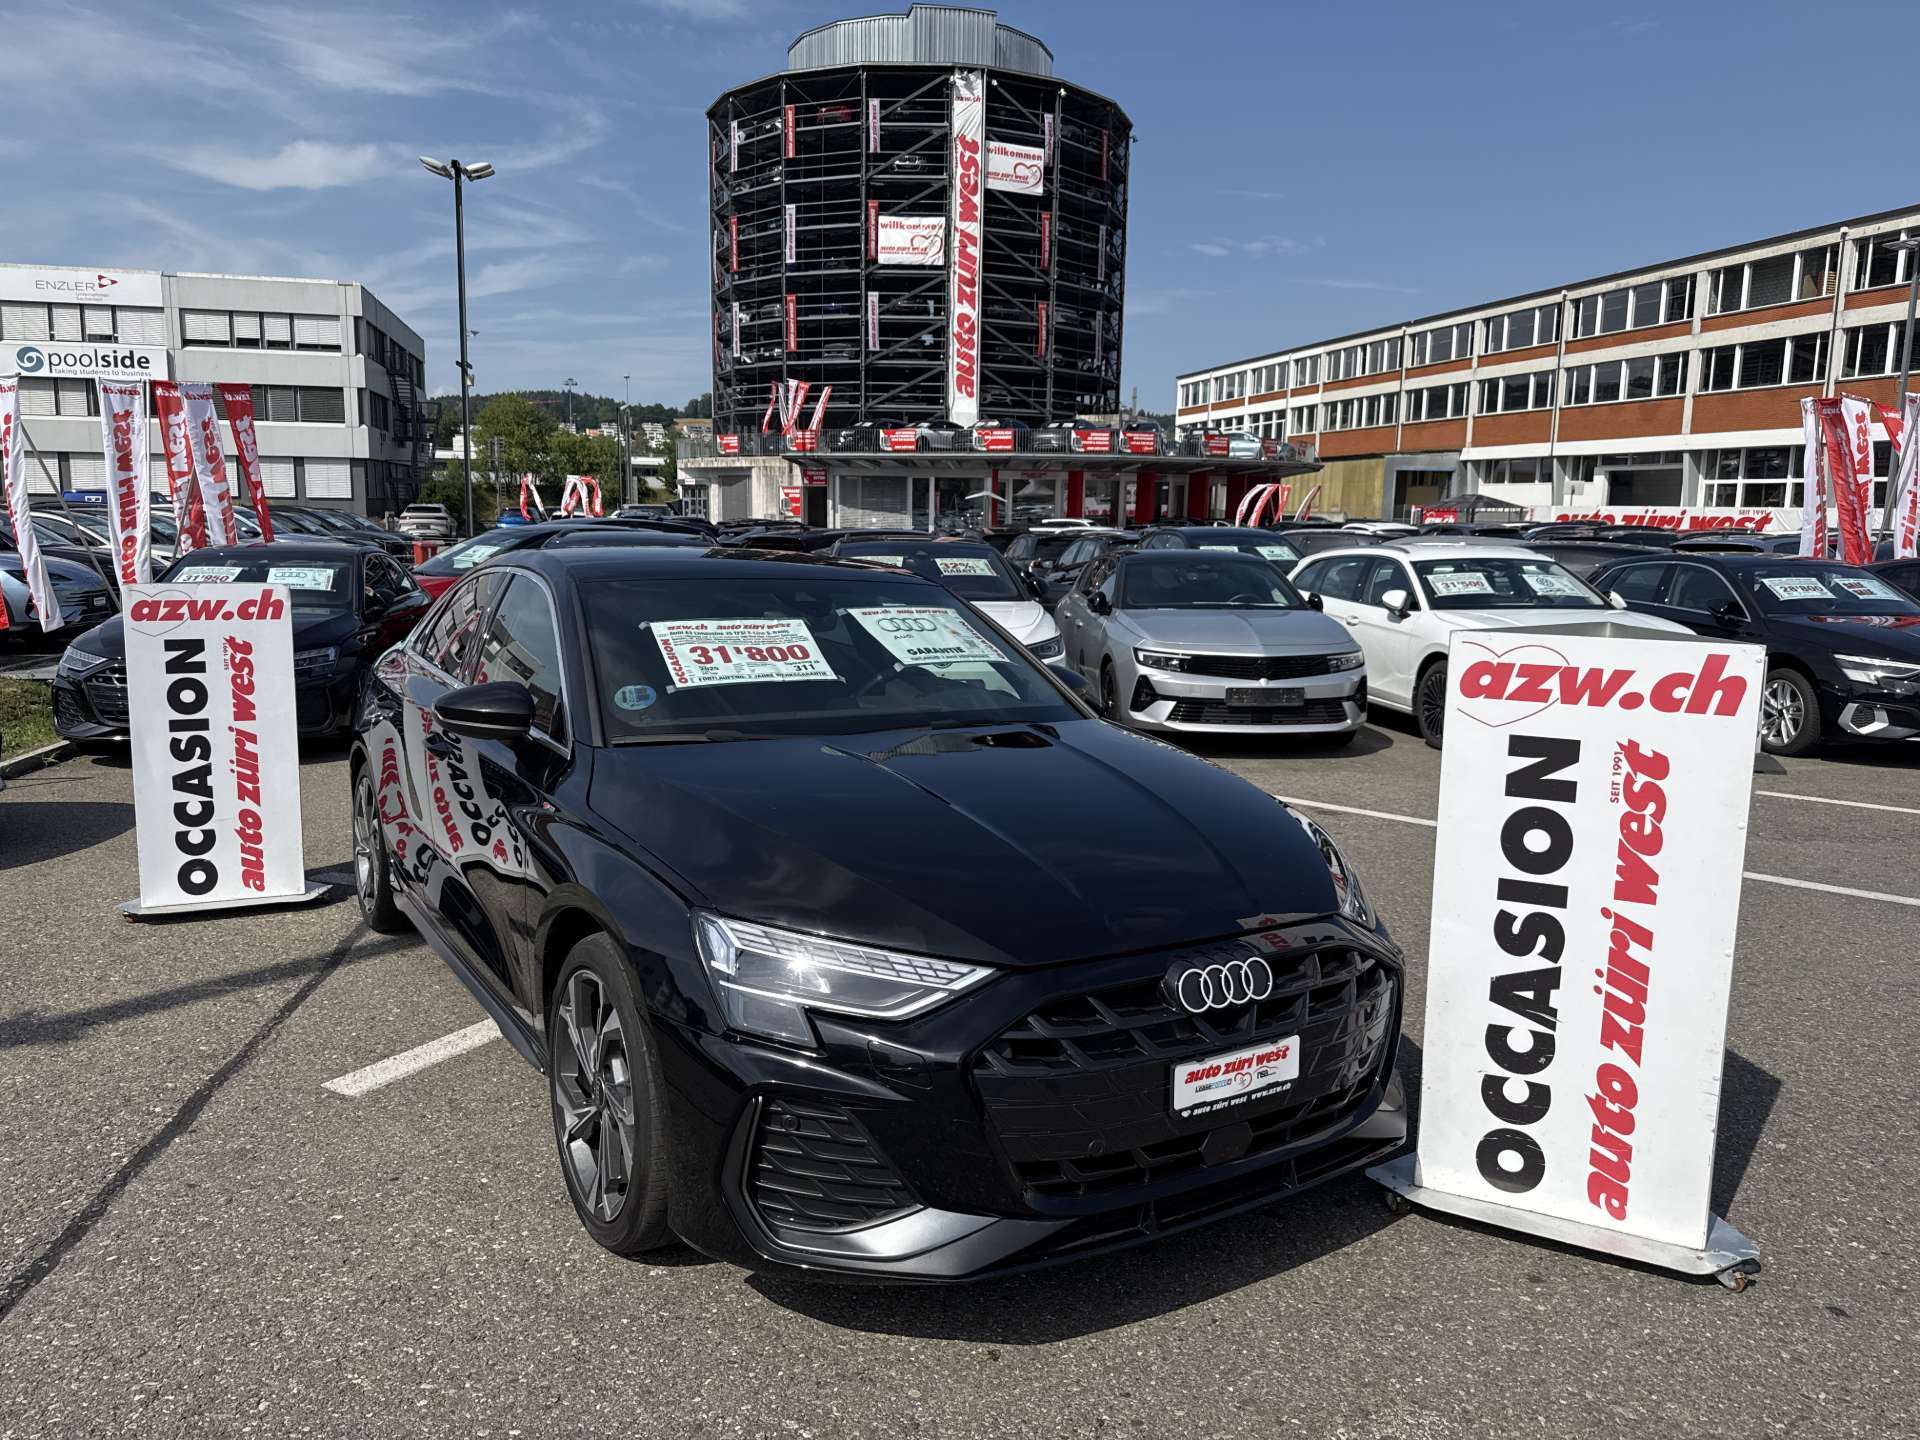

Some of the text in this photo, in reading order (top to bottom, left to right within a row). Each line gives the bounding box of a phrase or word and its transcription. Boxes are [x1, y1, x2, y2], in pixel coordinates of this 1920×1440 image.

[986, 145, 1042, 161] willkommen
[952, 133, 980, 400] auto züri west
[35, 279, 96, 292] ENZLER
[47, 348, 151, 374] poolside
[54, 367, 152, 378] taking students to business
[130, 588, 284, 622] azw.ch
[661, 638, 689, 685] OCCASION
[689, 643, 811, 665] 31'800
[793, 663, 816, 672] 311
[906, 646, 967, 657] GARANTIE
[1459, 652, 1748, 718] azw.ch
[164, 637, 219, 897] OCCASION
[223, 634, 266, 893] auto züri west
[1609, 751, 1624, 804] SEIT 1991
[1475, 732, 1582, 1194] OCCASION
[1583, 737, 1672, 1222] auto züri west
[1184, 1045, 1290, 1085] auto züri west
[1192, 1082, 1291, 1116] auto züri west www.azw.ch
